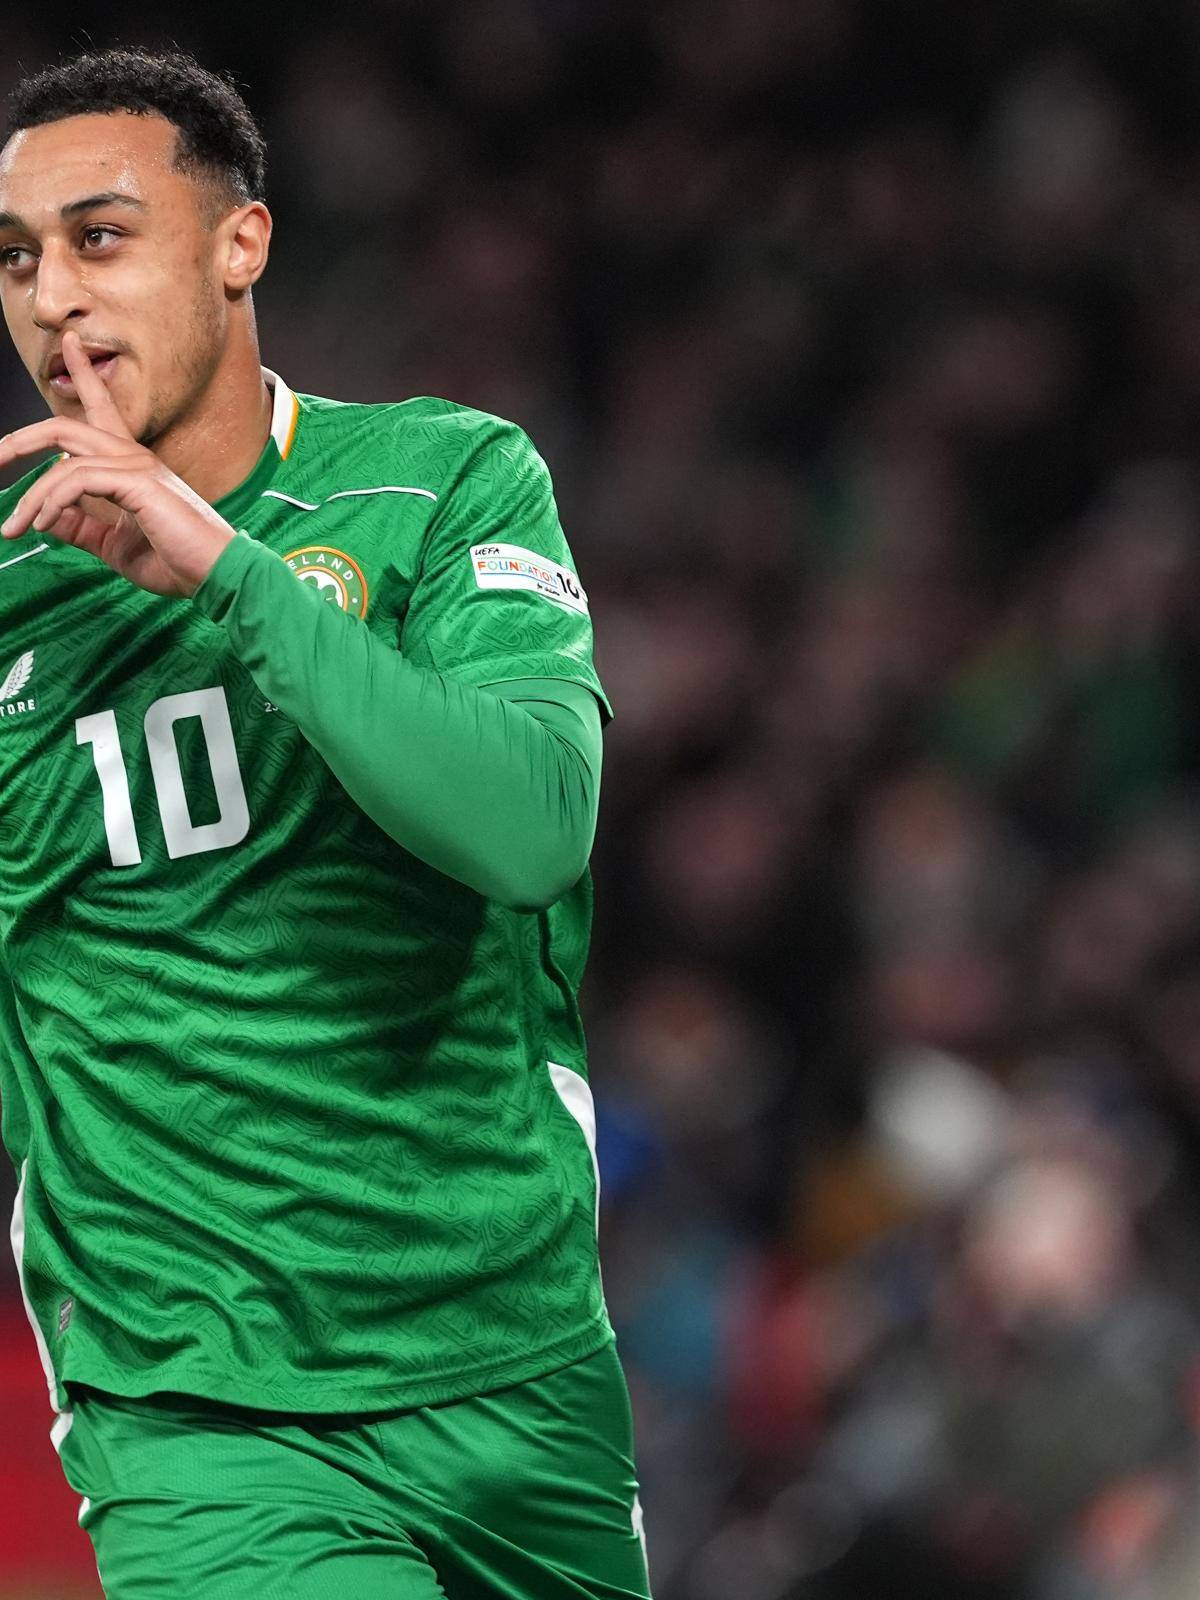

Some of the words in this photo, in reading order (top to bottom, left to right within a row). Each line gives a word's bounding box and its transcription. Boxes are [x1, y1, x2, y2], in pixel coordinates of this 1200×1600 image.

[474, 547, 500, 556] UEFA
[287, 553, 354, 581] ELAND
[477, 560, 558, 585] FOUNDATION
[75, 685, 250, 867] 10
